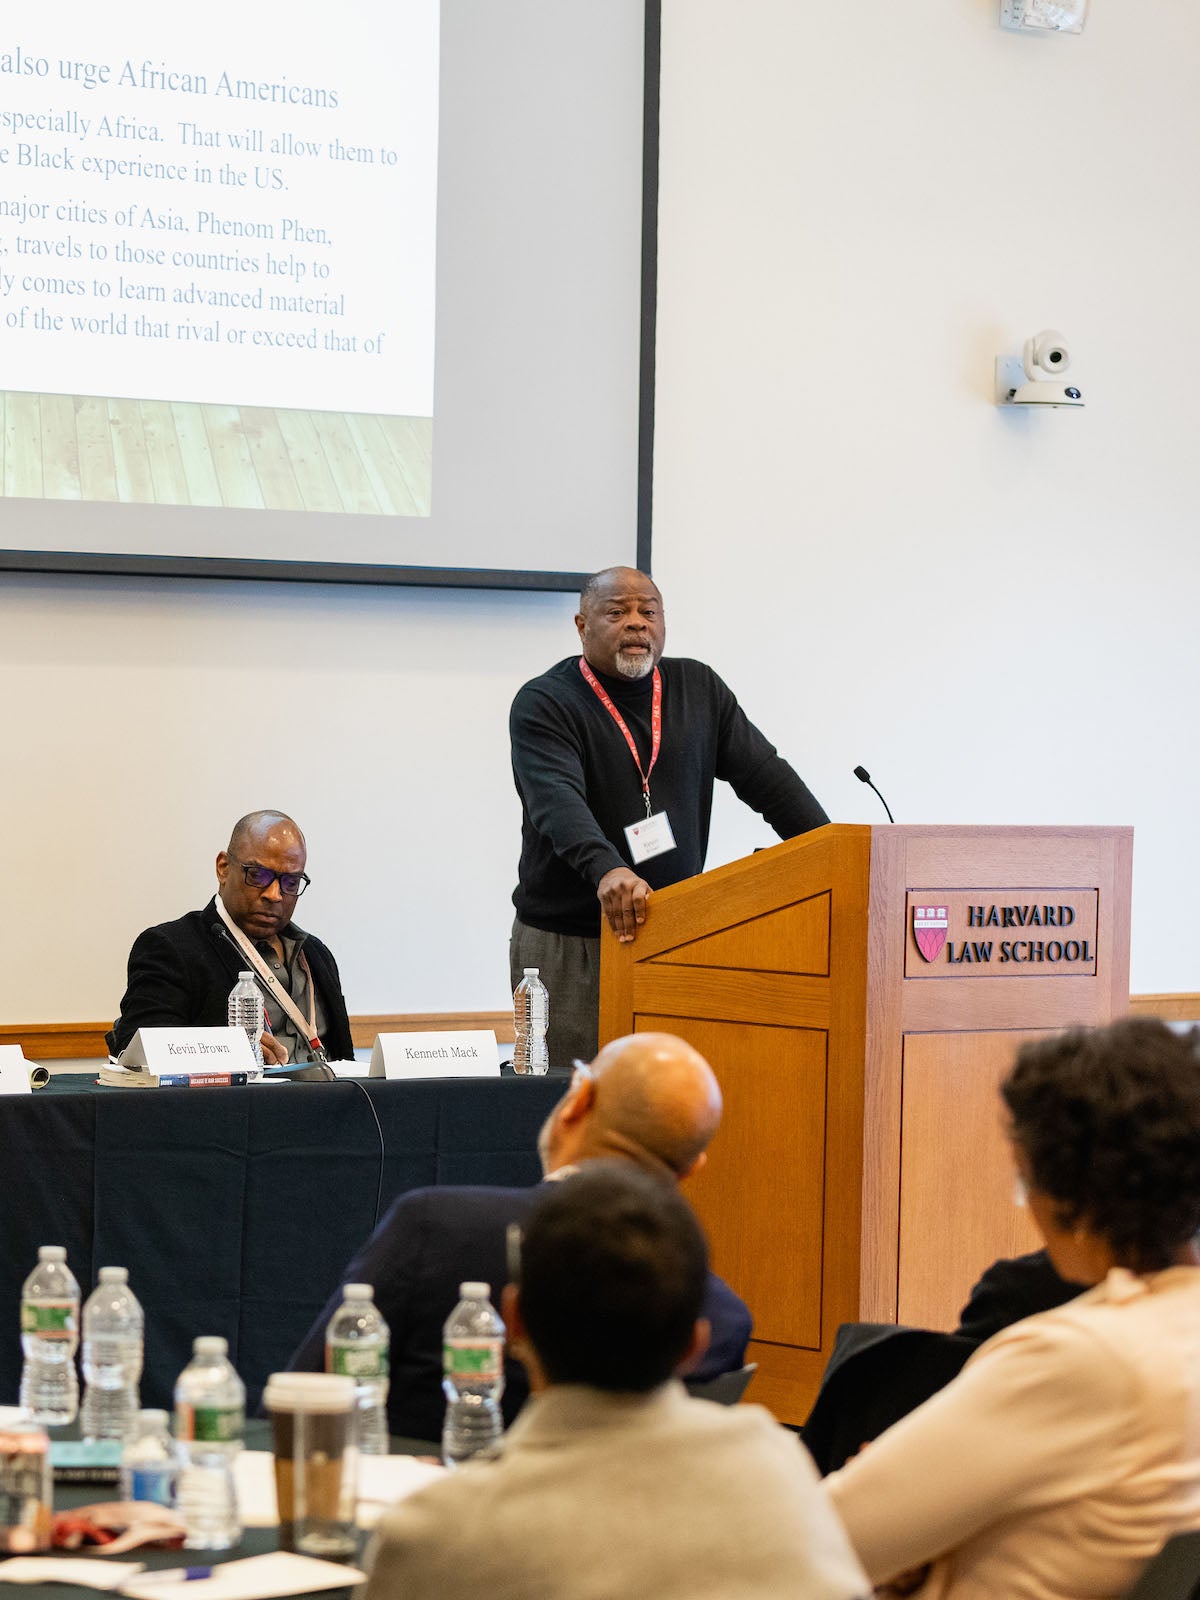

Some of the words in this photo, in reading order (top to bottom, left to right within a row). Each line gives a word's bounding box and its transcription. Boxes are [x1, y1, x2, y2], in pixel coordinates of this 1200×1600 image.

[0, 45, 50, 77] also
[57, 59, 111, 91] urge
[117, 59, 208, 95] African
[213, 70, 339, 109] Americans
[95, 114, 165, 143] Africa.
[176, 121, 222, 148] That
[226, 128, 264, 153] will
[270, 132, 323, 158] allow
[328, 137, 375, 164] them
[380, 147, 399, 166] to
[16, 142, 76, 171] Black
[81, 153, 188, 181] experience
[193, 159, 212, 184] in
[218, 162, 248, 187] the
[253, 166, 289, 191] US.
[55, 198, 108, 225] cities
[114, 204, 138, 227] of
[139, 207, 190, 233] Asia,
[197, 210, 275, 240] Phenom
[280, 218, 332, 246] Phen,
[15, 234, 83, 259] travels
[89, 240, 108, 261] to
[114, 239, 167, 266] those
[171, 248, 260, 273] countries
[265, 251, 307, 284] help
[312, 260, 330, 279] to
[21, 275, 86, 296] comes
[92, 278, 112, 298] to
[119, 275, 166, 303] learn
[172, 281, 264, 310] advanced
[269, 292, 345, 317] material
[5, 305, 30, 329] of
[33, 306, 64, 331] the
[69, 311, 128, 336] world
[133, 314, 171, 339] that
[176, 317, 221, 343] rival
[226, 328, 247, 345] or
[251, 327, 318, 350] exceed
[323, 328, 358, 353] that
[363, 332, 386, 355] of
[968, 905, 1075, 927] HARVARD
[947, 941, 993, 963] LAW
[1000, 940, 1094, 963] SCHOOL
[167, 1043, 197, 1055] Kevin
[197, 1042, 230, 1054] Brown
[405, 1047, 449, 1059] Kenneth
[450, 1046, 478, 1058] Mack
